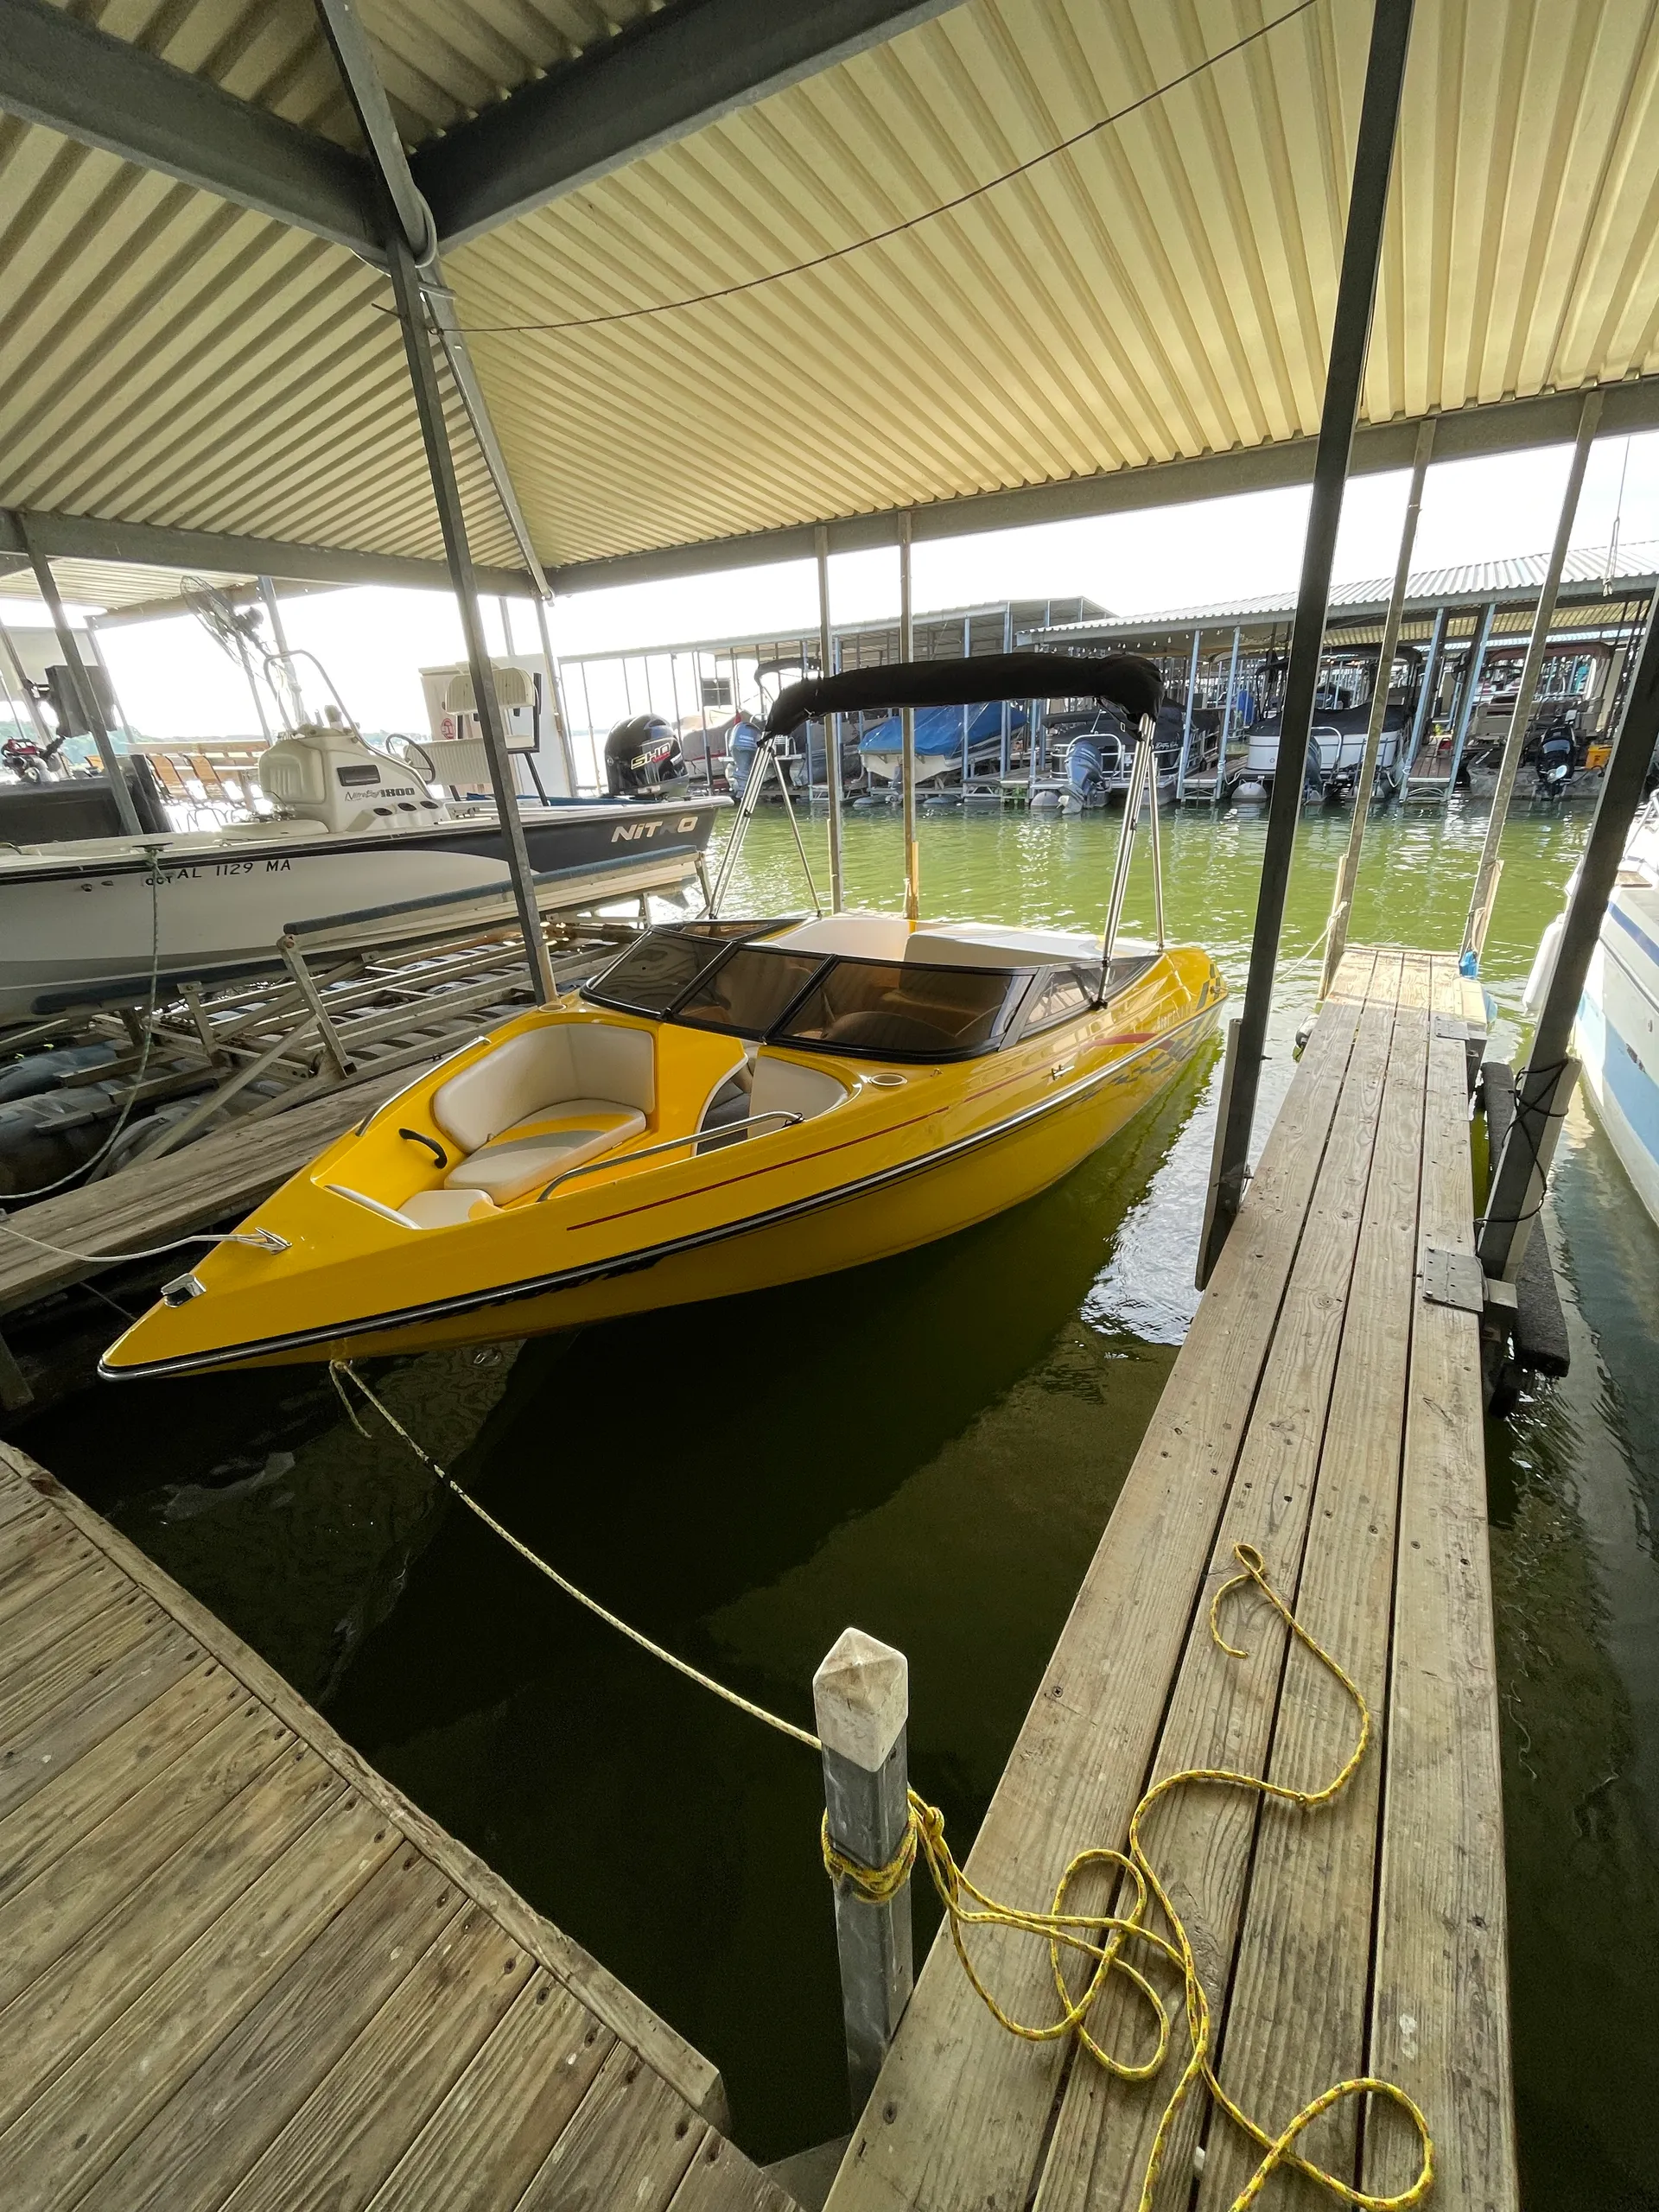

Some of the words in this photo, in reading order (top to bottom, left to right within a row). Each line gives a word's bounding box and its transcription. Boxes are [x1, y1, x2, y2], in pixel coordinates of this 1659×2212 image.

[380, 787, 415, 798] 1800
[177, 868, 202, 880] AL
[216, 862, 254, 876] 1129
[266, 859, 291, 873] MA
